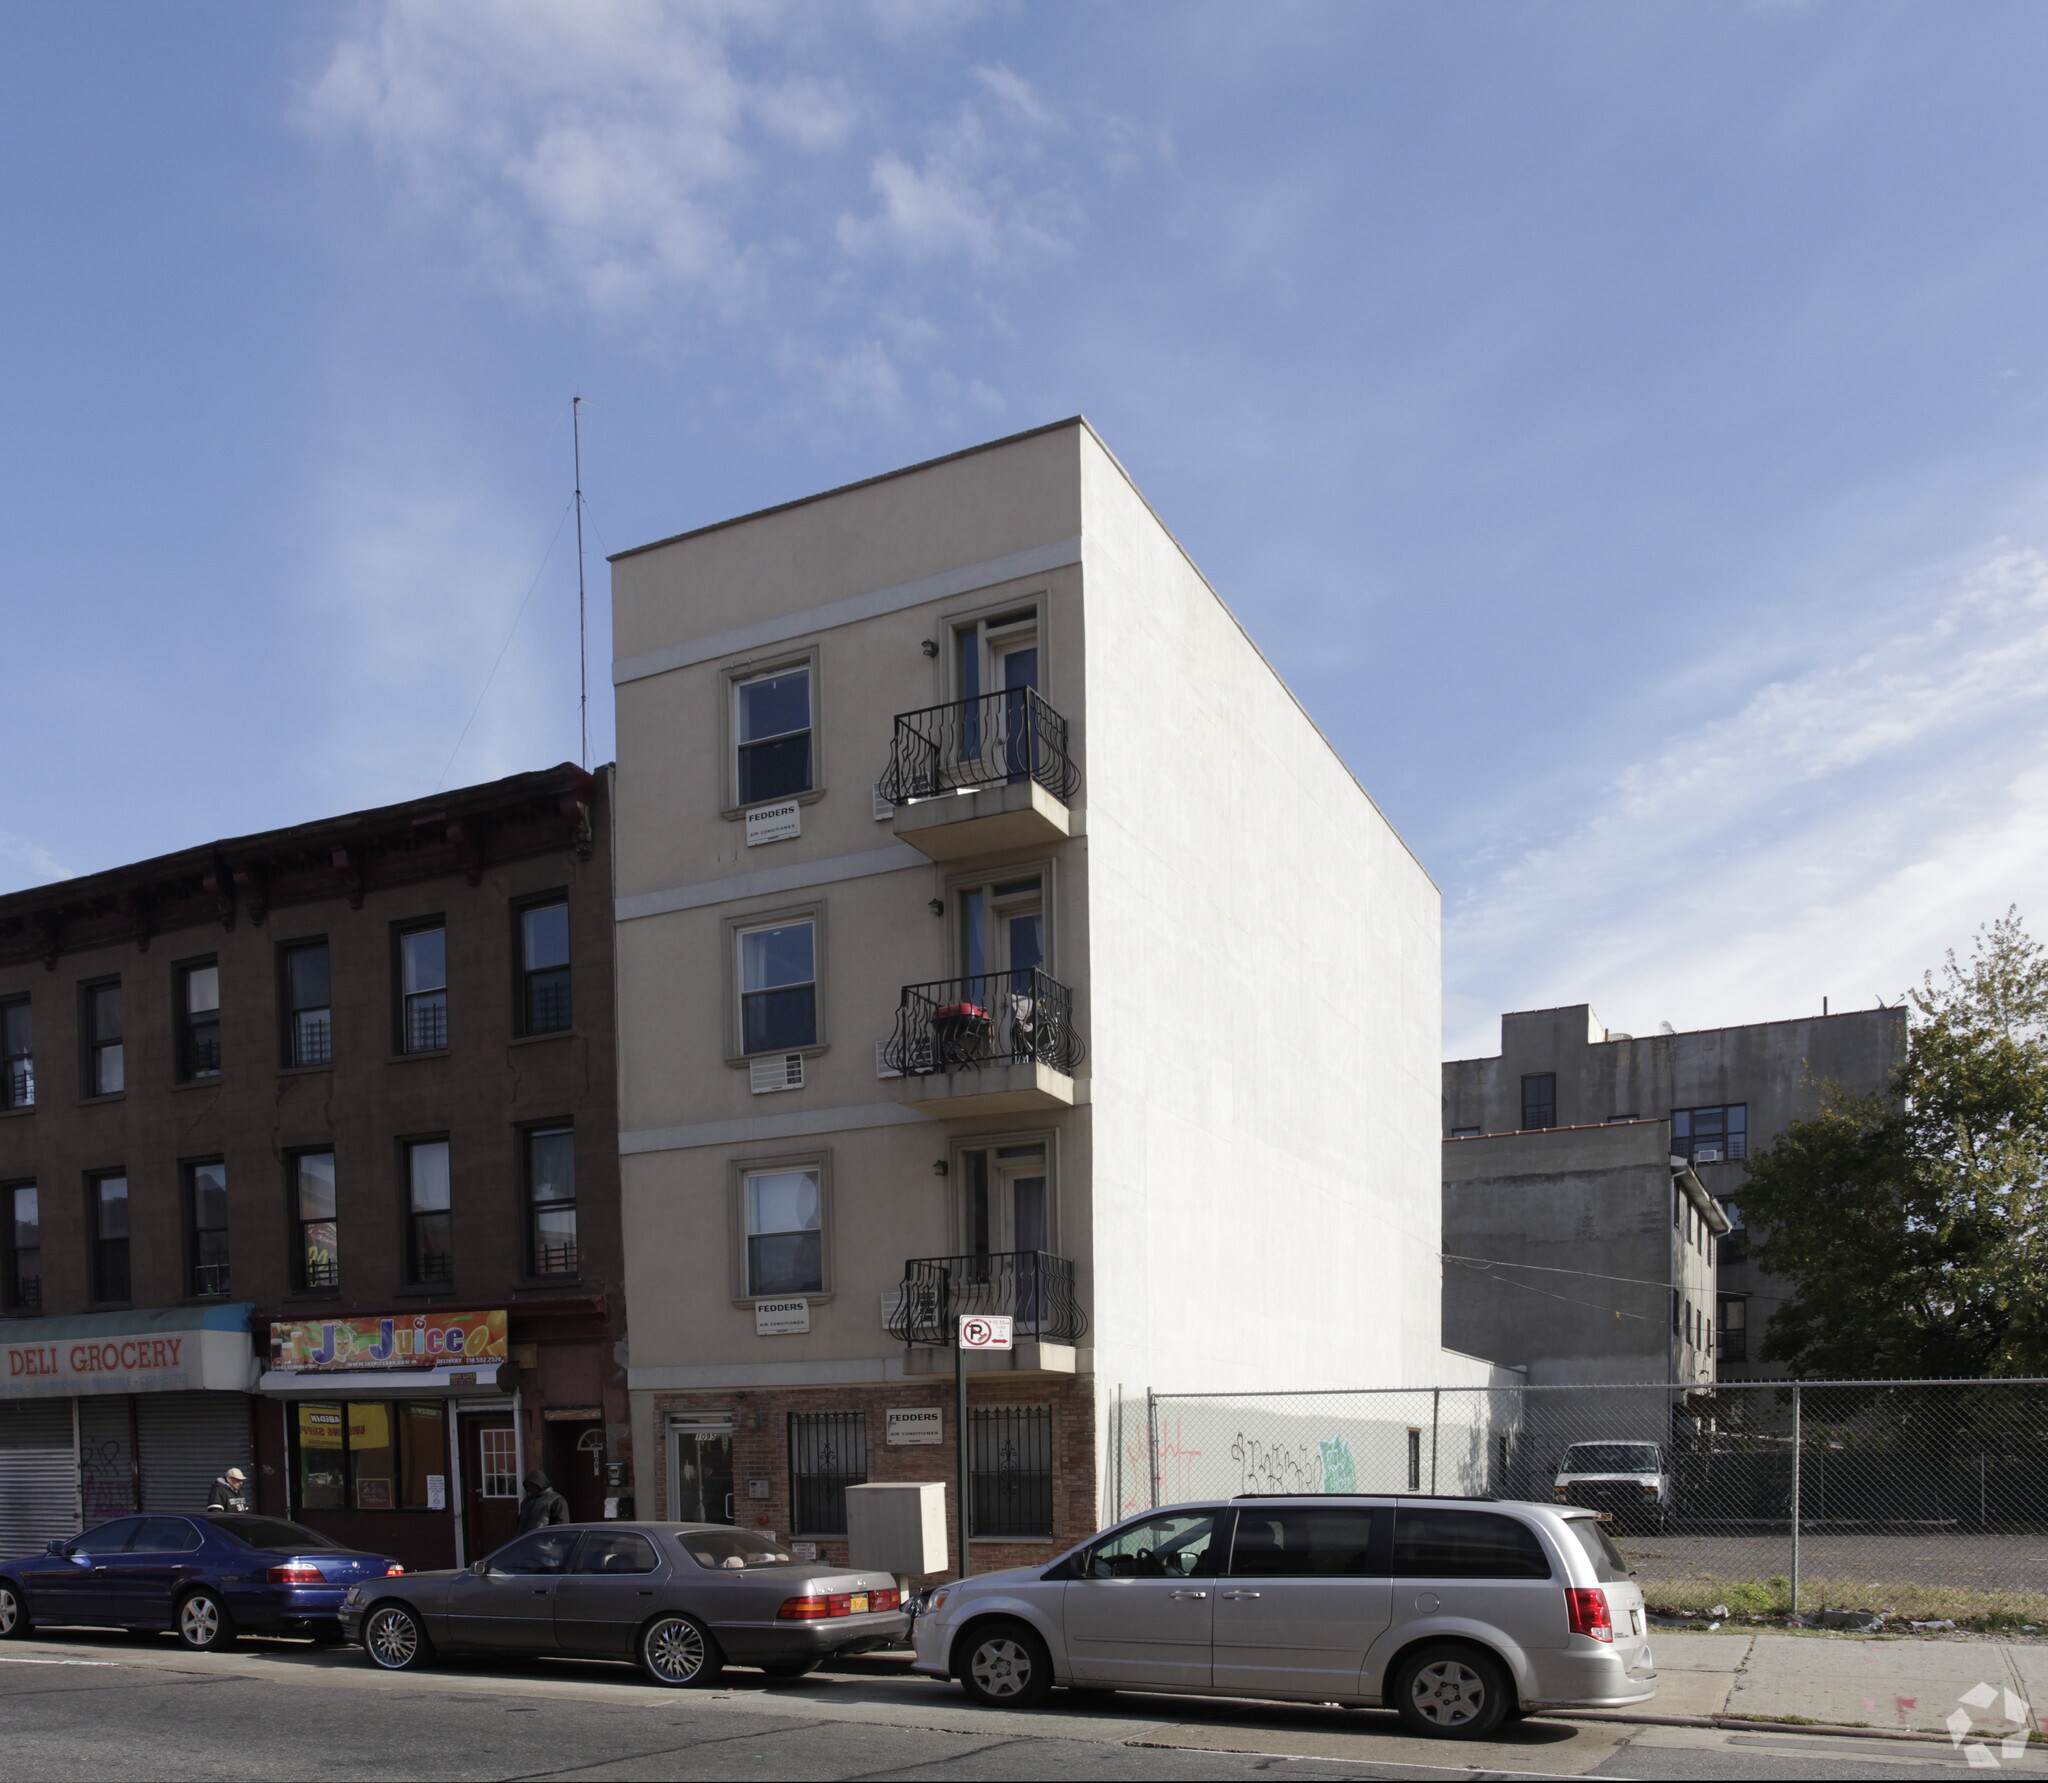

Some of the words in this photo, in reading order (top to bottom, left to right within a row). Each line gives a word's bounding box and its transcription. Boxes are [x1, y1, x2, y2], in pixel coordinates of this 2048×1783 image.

[748, 805, 795, 822] FEDDERS
[758, 1302, 804, 1312] FEDDERS
[368, 1317, 465, 1361] Juice
[9, 1347, 58, 1376] DELI
[69, 1338, 182, 1373] GROCERY
[889, 1413, 938, 1422] FEDDERS
[694, 1433, 717, 1441] 1095
